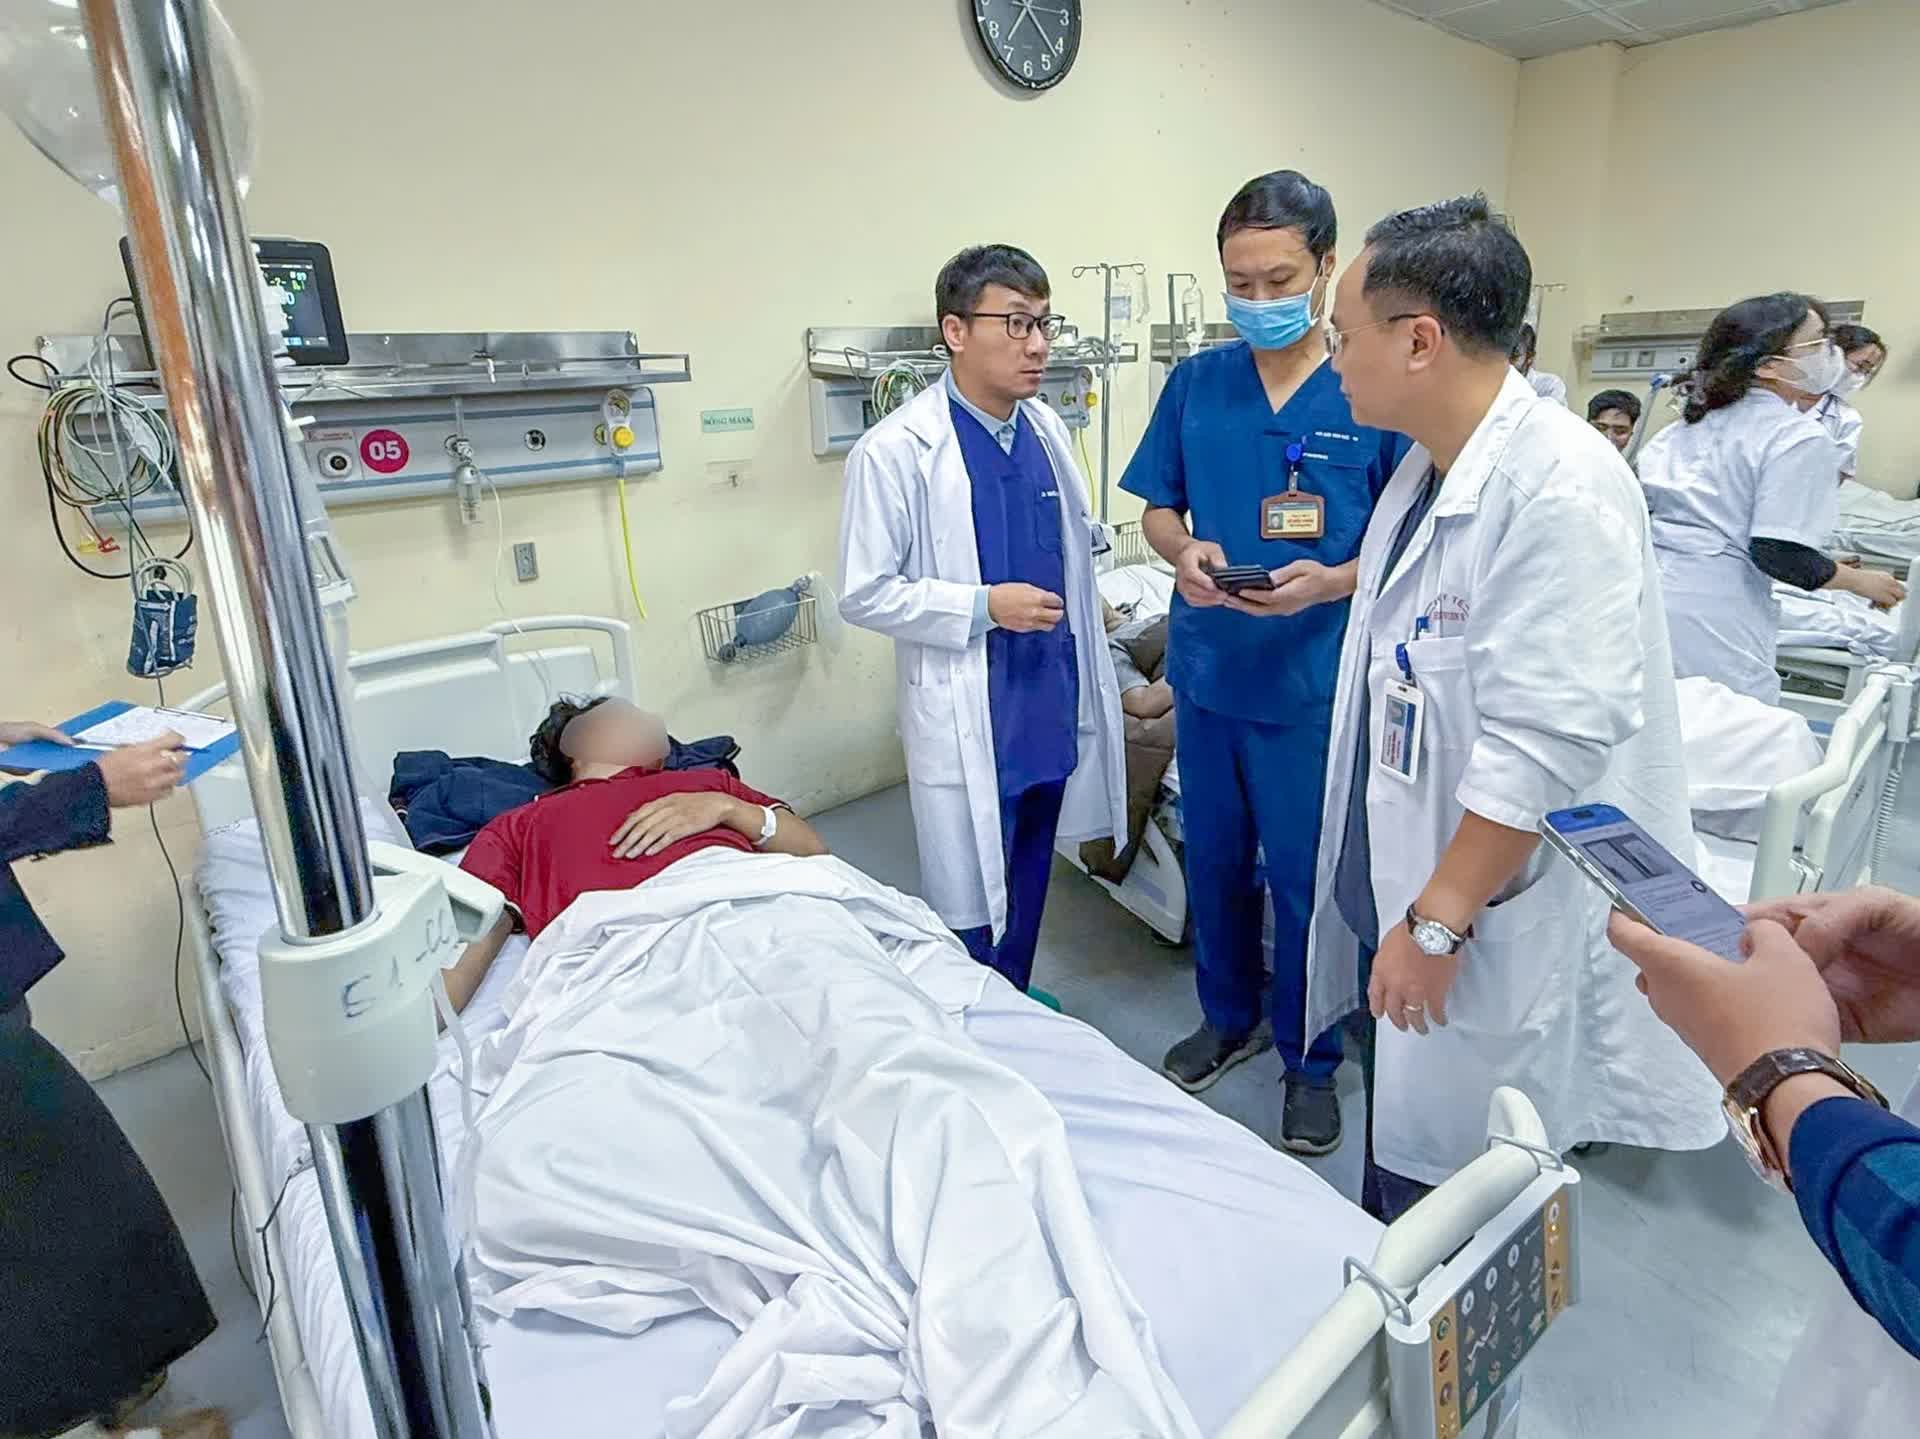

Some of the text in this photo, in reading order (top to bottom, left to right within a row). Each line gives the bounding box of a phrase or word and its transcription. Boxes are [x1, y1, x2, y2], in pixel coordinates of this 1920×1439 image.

[1060, 9, 1070, 26] 3
[989, 20, 1000, 39] 8
[1003, 44, 1015, 63] 7
[1054, 37, 1065, 54] 4
[1023, 60, 1033, 78] 6
[1041, 53, 1052, 71] 5
[368, 440, 402, 461] 05
